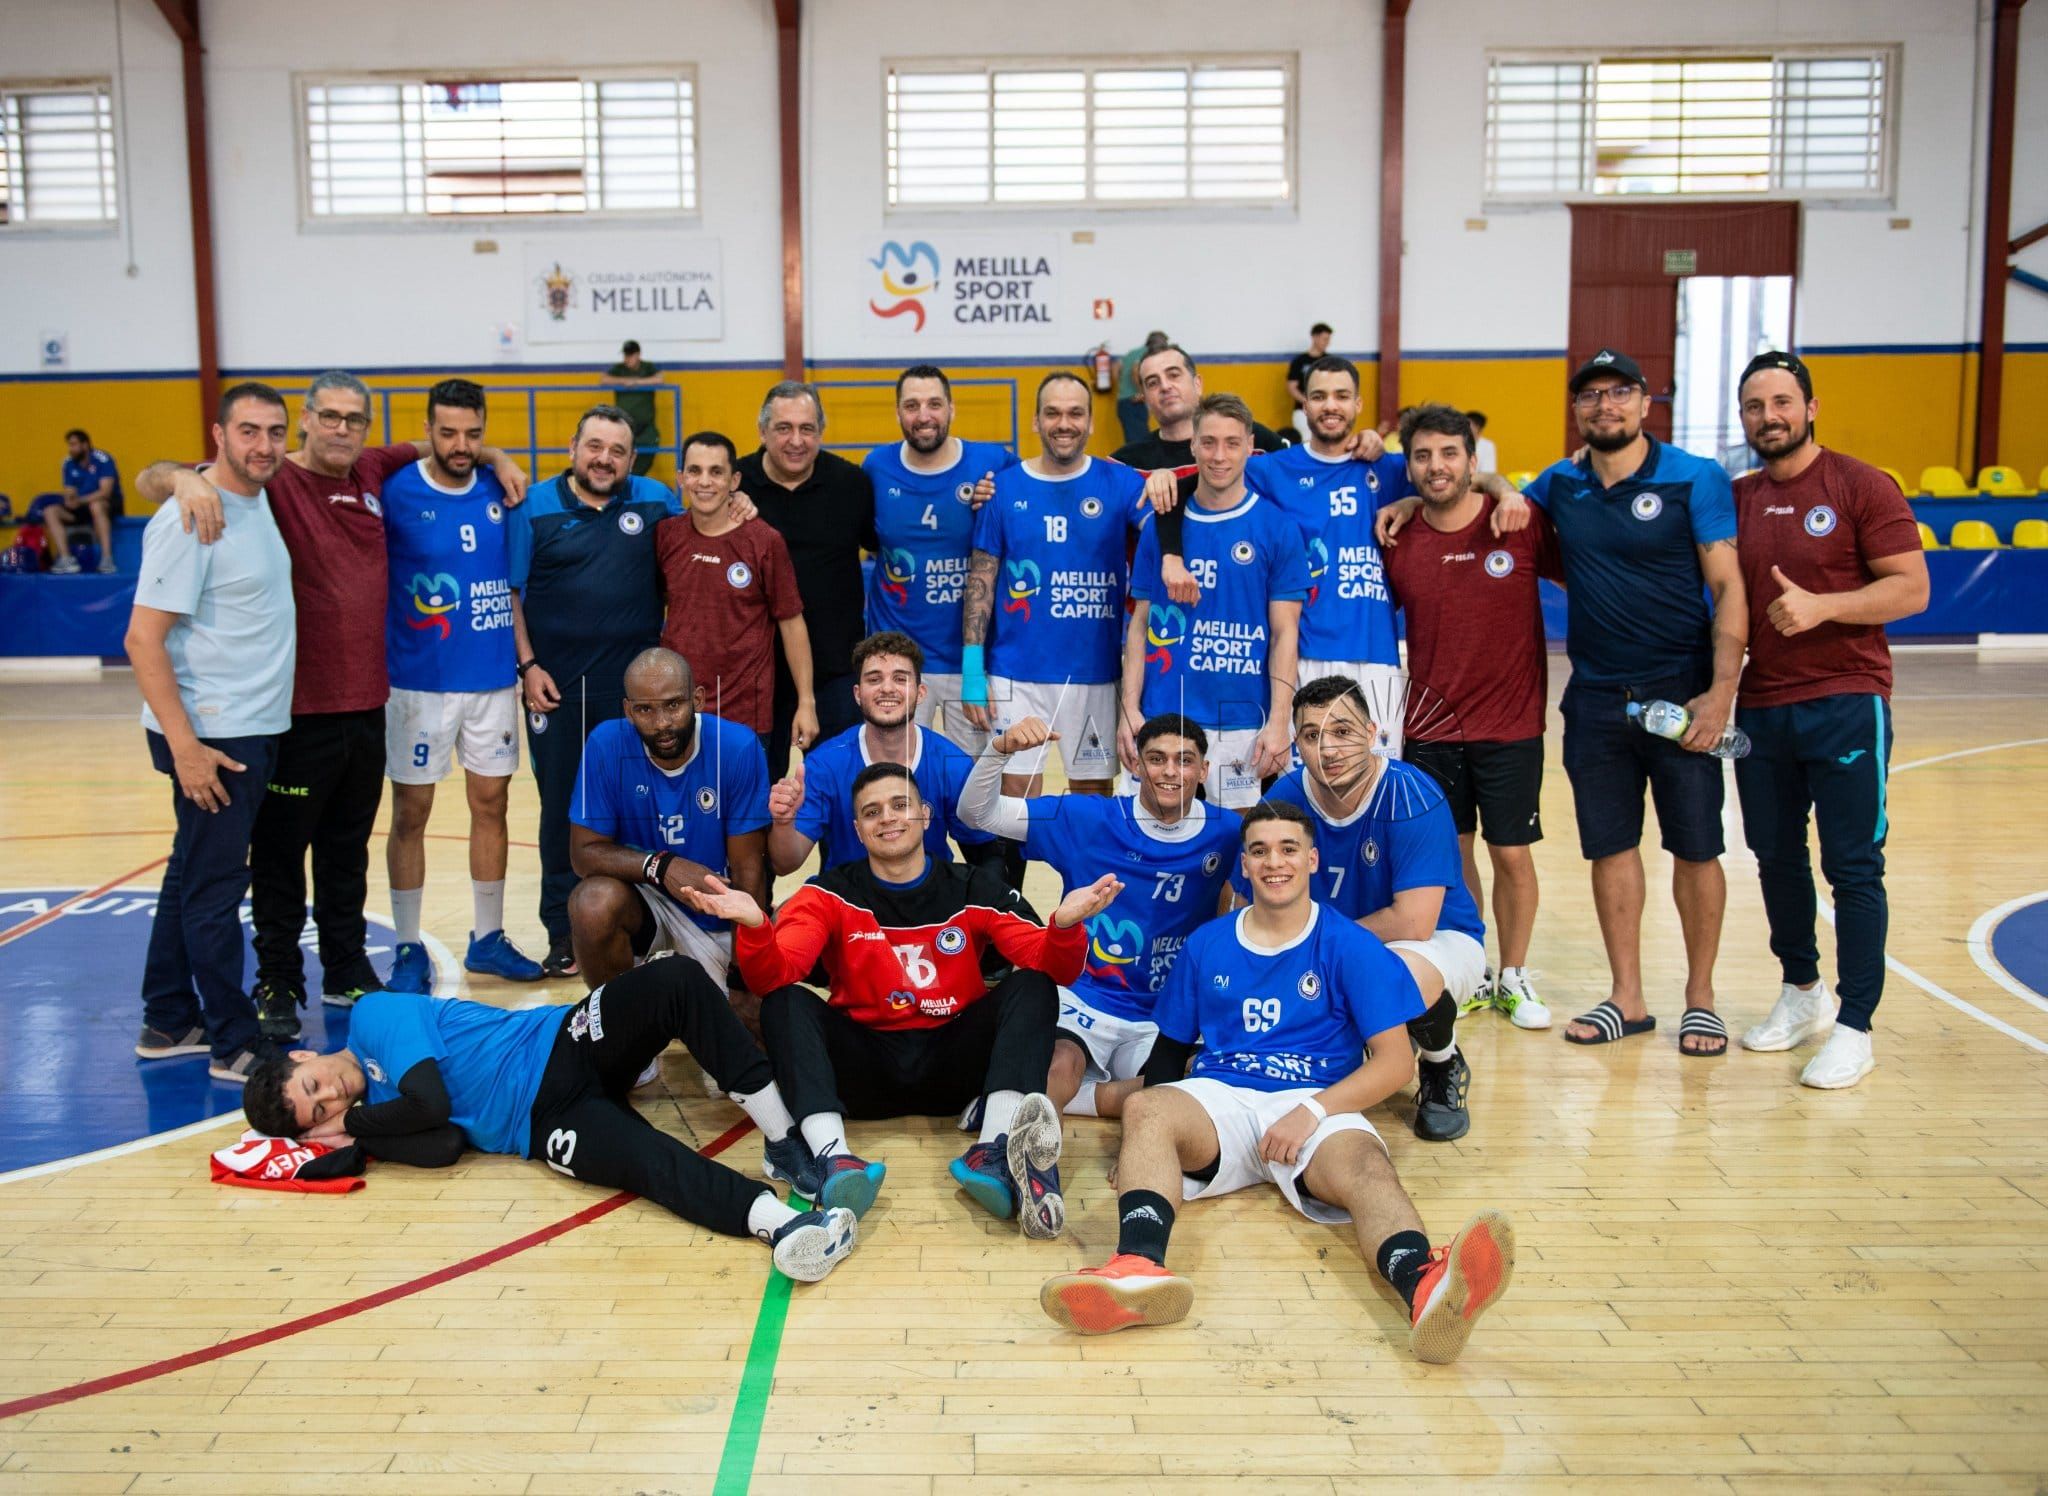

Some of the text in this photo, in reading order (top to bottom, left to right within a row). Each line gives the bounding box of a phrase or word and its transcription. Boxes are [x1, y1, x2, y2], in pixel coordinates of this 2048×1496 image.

[953, 257, 1051, 277] MELILLA
[588, 273, 635, 284] CIUDAD
[592, 288, 715, 313] MELILLA
[954, 281, 1034, 300] SPORT
[954, 304, 1052, 324] CAPITAL
[1329, 486, 1358, 517] 55
[921, 504, 939, 530] 4
[459, 523, 478, 553] 9
[1043, 515, 1068, 543] 18
[1050, 571, 1117, 587] MELILLA
[1189, 558, 1218, 589] 26
[1050, 588, 1108, 602] SPORT
[1050, 604, 1115, 618] CAPITAL
[1192, 619, 1266, 641] MELILLA
[1191, 638, 1252, 657] SPORT
[1189, 655, 1262, 675] CAPITAL
[412, 743, 429, 767] 9
[1151, 872, 1186, 902] 73
[1327, 866, 1346, 898] 7
[920, 996, 957, 1008] MELILLA
[1242, 997, 1281, 1033] 69
[547, 1127, 577, 1178] 13
[1121, 1212, 1164, 1226] adidas
